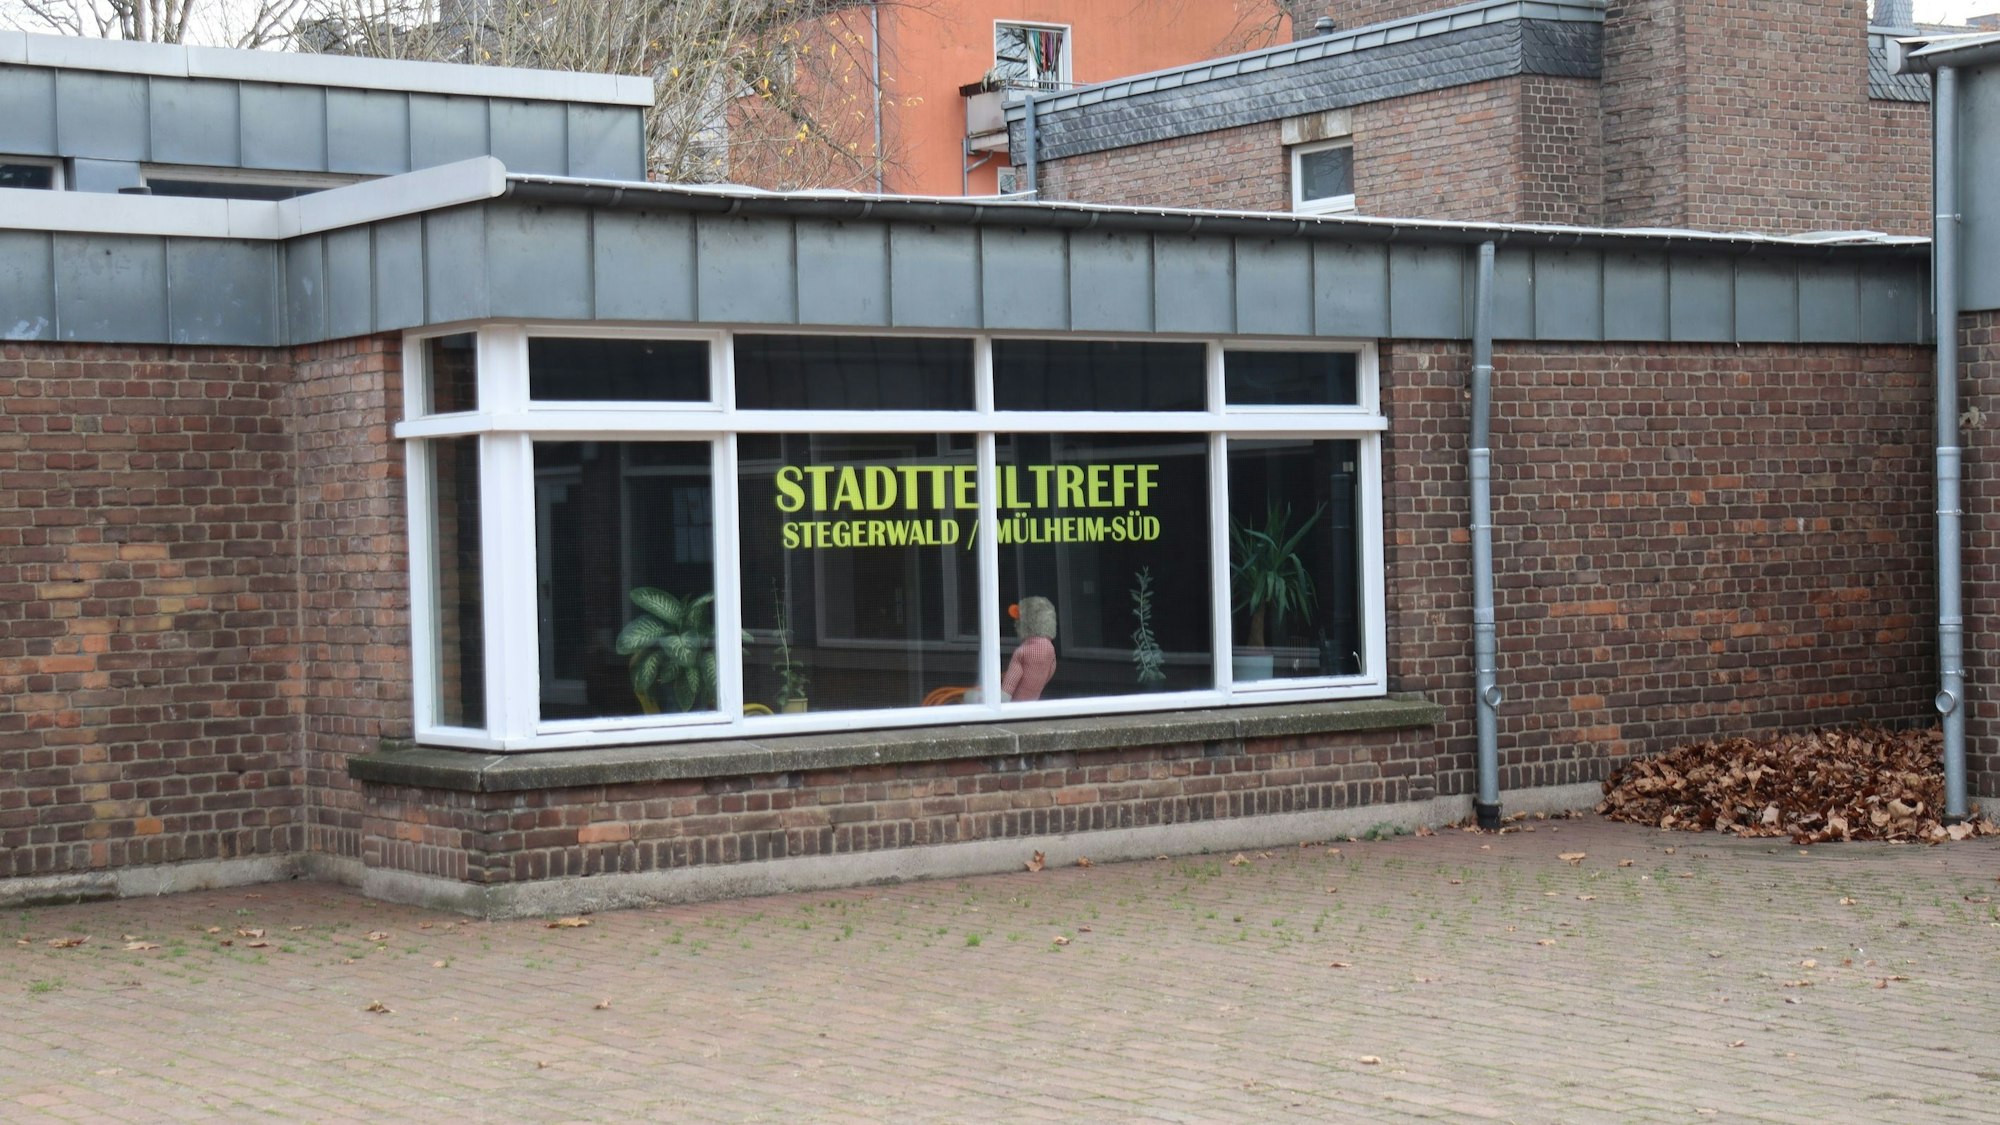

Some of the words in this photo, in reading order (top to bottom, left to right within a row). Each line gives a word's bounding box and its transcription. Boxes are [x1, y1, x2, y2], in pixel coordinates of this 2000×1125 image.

[783, 519, 959, 548] STEGERWALD
[967, 519, 979, 550] /
[996, 511, 1160, 544] MÜLHEIM-SÜD
